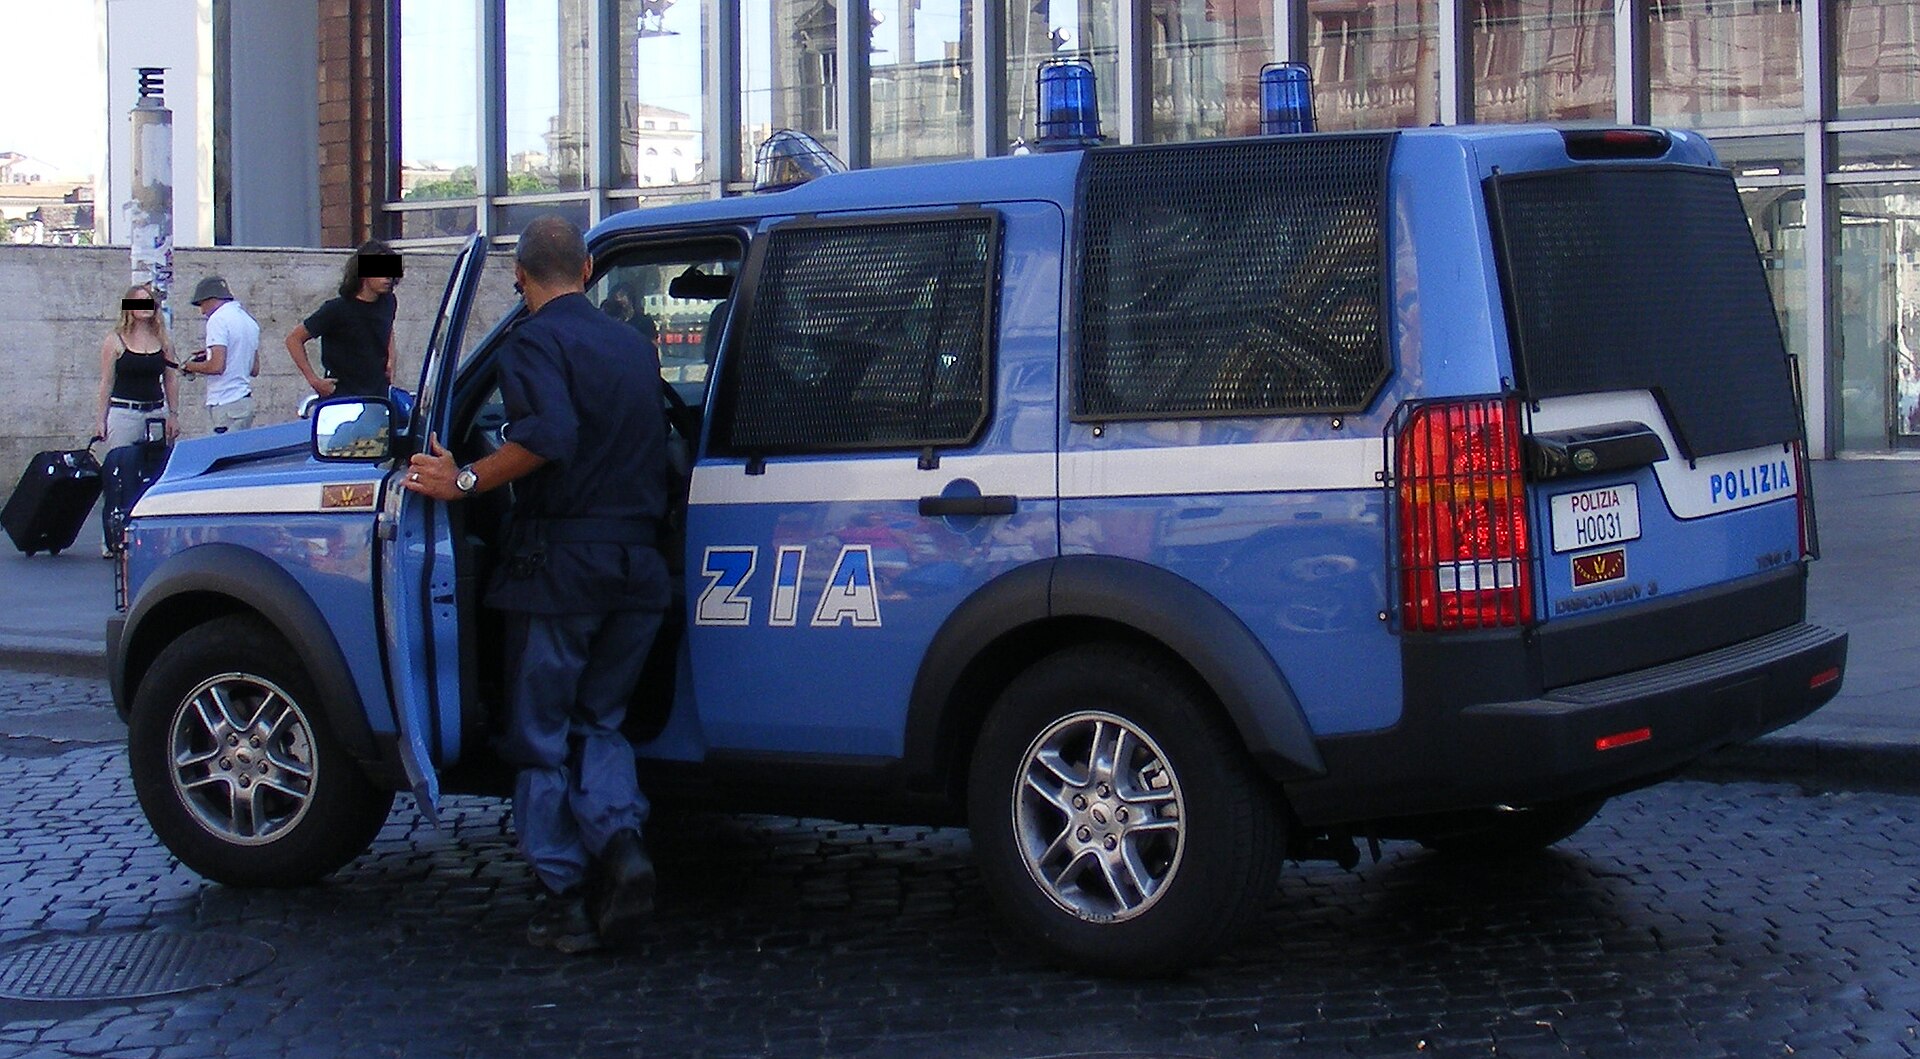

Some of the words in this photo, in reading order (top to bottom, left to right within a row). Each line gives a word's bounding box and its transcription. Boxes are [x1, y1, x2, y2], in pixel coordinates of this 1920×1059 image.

[1571, 490, 1620, 512] POLIZIA
[1711, 460, 1790, 503] POLIZIA
[695, 544, 882, 626] ZIA
